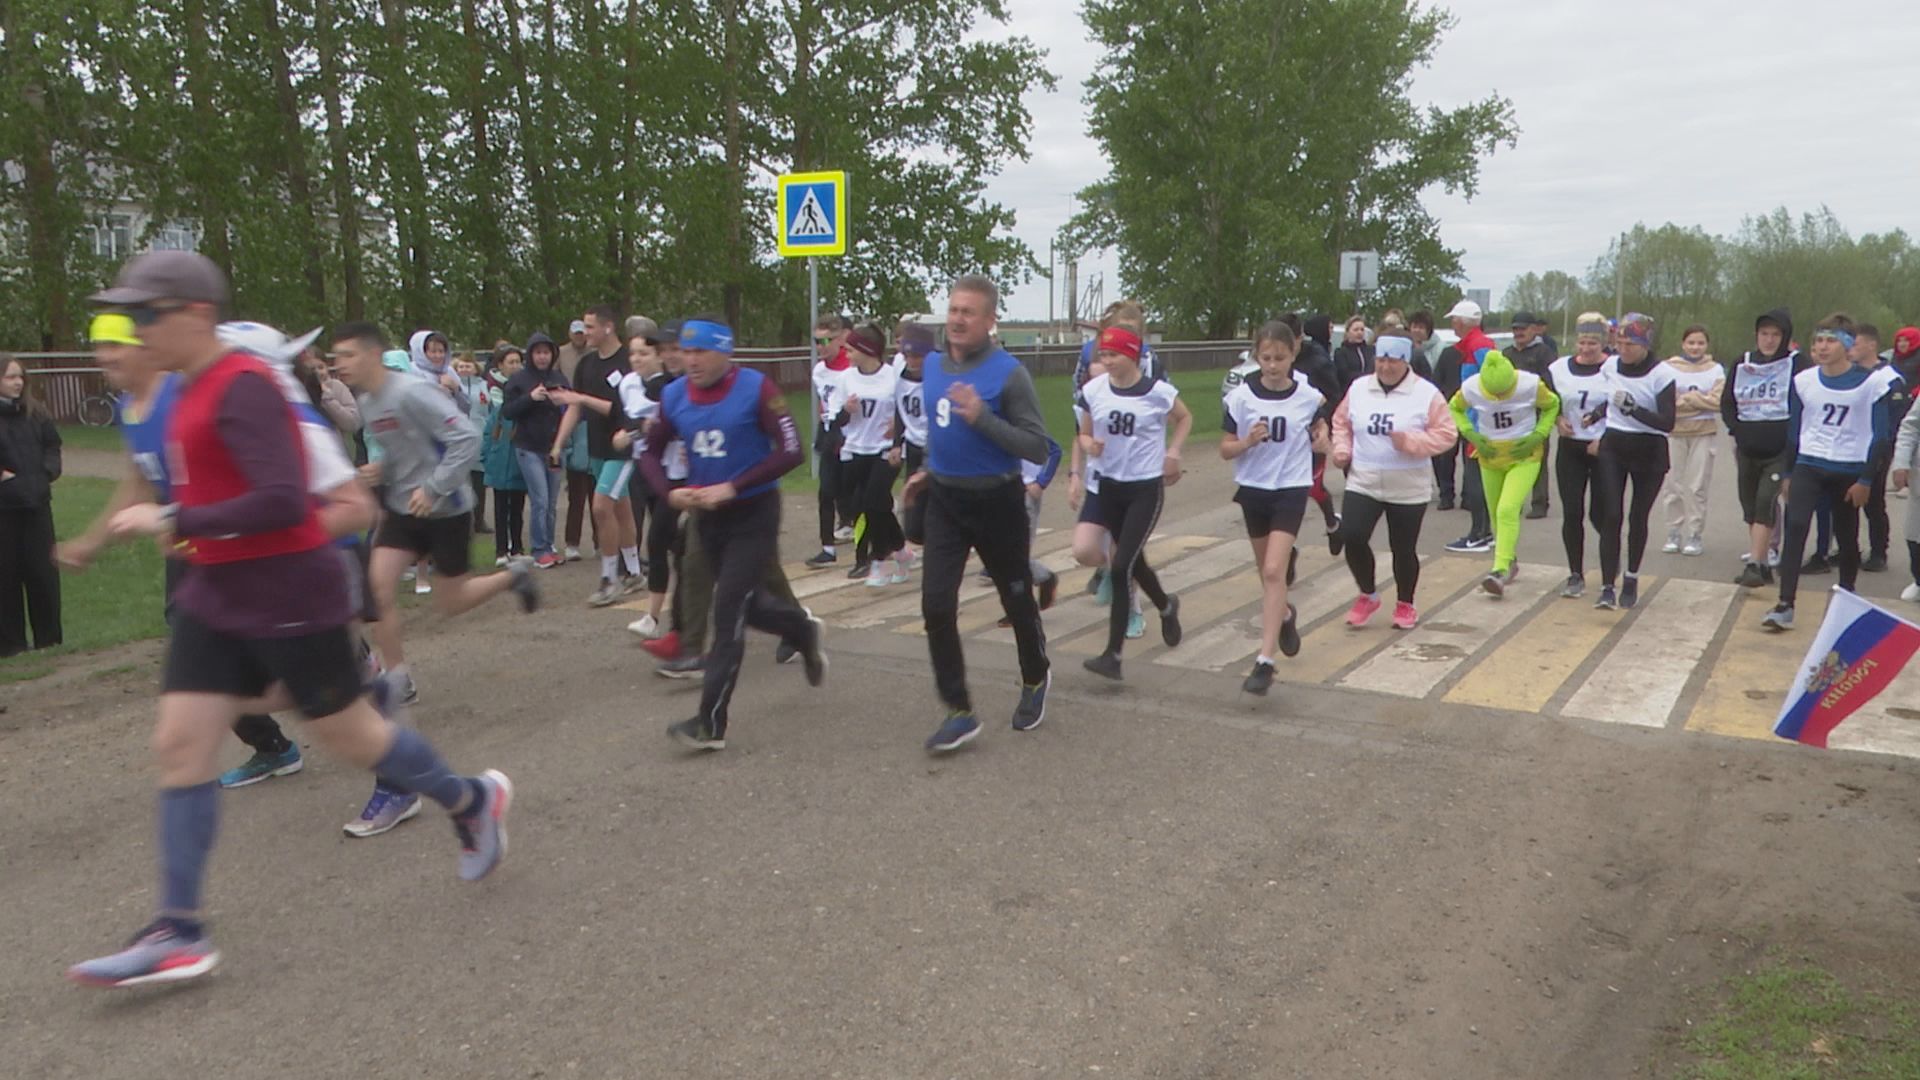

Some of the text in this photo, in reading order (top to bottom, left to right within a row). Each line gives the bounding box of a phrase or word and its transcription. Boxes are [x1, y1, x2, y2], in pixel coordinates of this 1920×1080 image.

[860, 398, 877, 418] 17
[1577, 390, 1589, 410] 7
[936, 398, 950, 428] 9
[1107, 410, 1135, 437] 38
[1367, 413, 1395, 436] 35
[1491, 411, 1513, 430] 15
[1822, 403, 1850, 427] 27
[692, 429, 727, 458] 42
